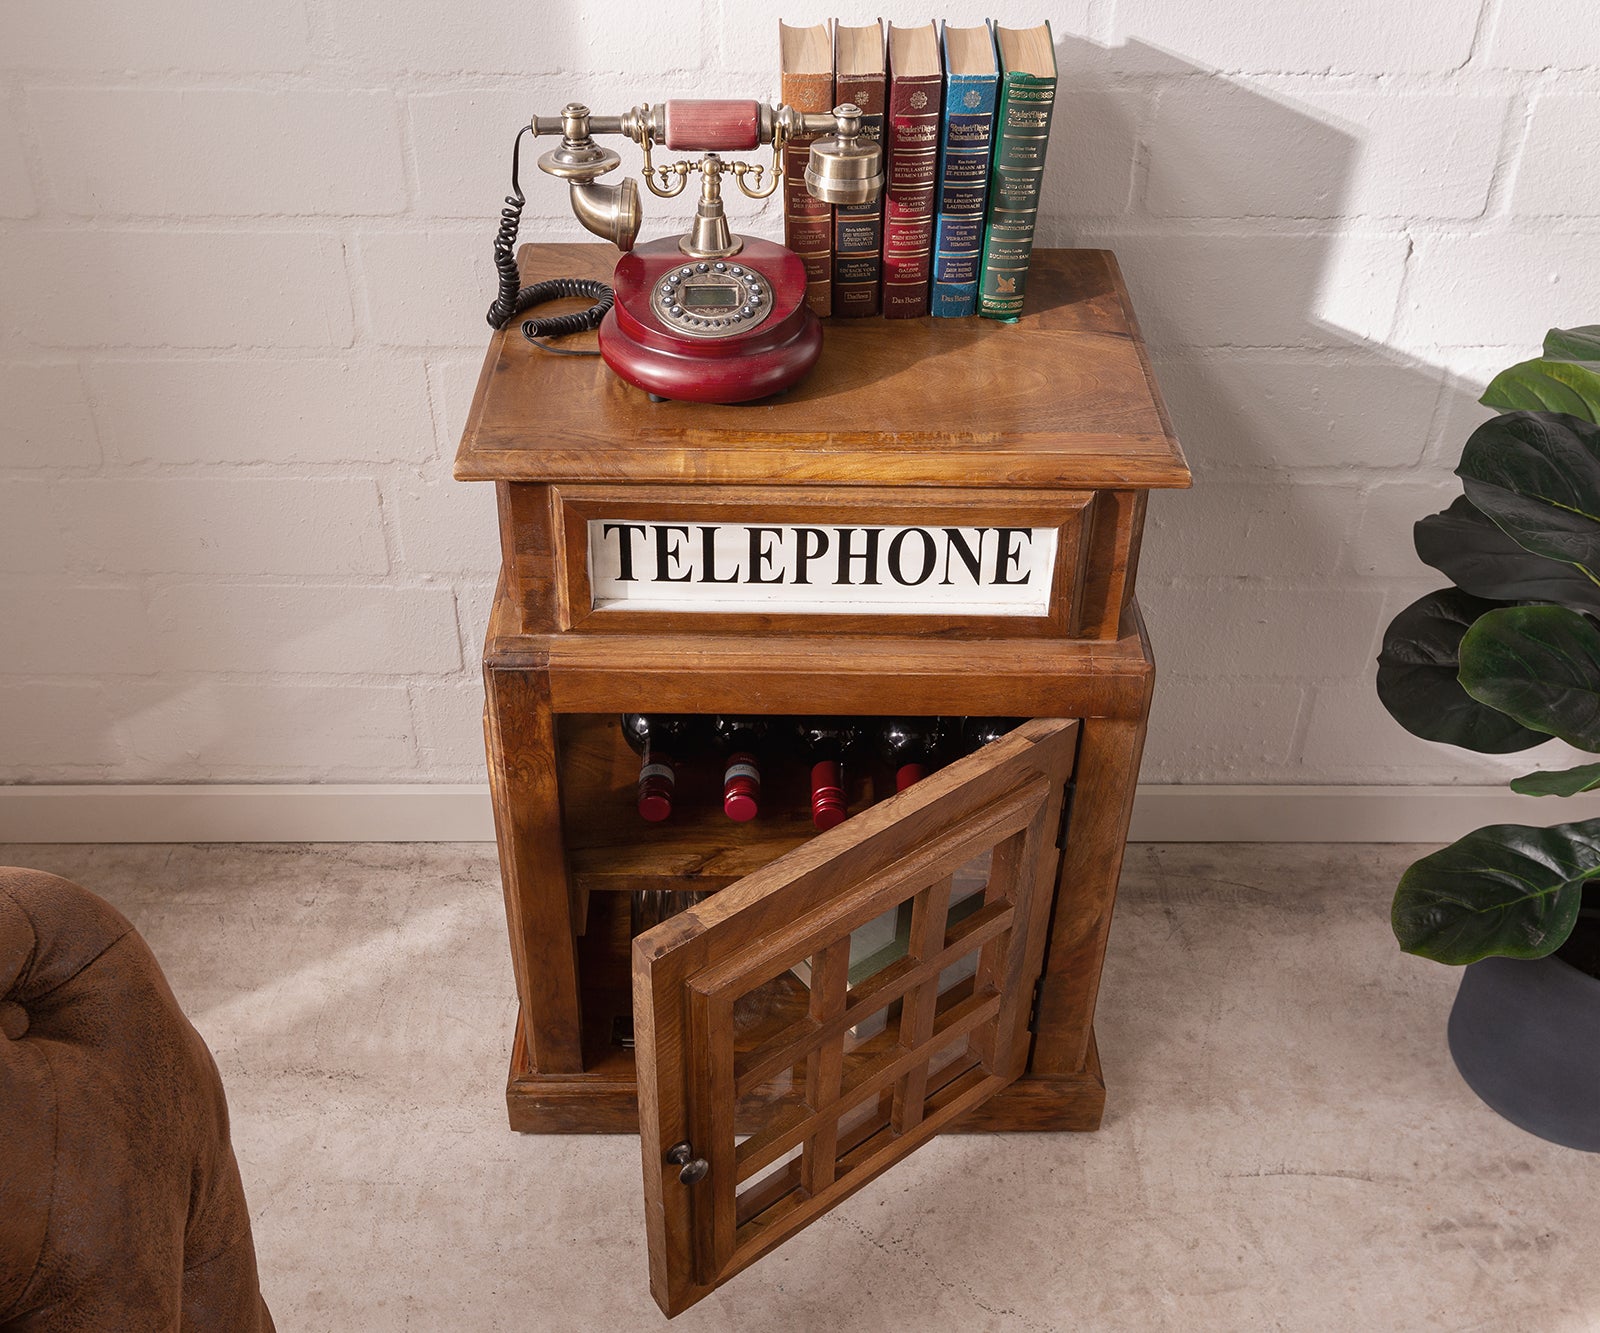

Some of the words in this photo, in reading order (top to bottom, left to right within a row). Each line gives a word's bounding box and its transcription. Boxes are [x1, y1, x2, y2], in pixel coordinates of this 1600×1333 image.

[1031, 110, 1048, 119] Digest
[897, 124, 921, 135] Reader's
[921, 124, 936, 133] Digest
[950, 123, 975, 134] Reader's
[975, 123, 990, 133] Digest
[892, 296, 904, 304] Das
[905, 296, 921, 304] Beste
[603, 523, 1033, 585] TELEPHONE
